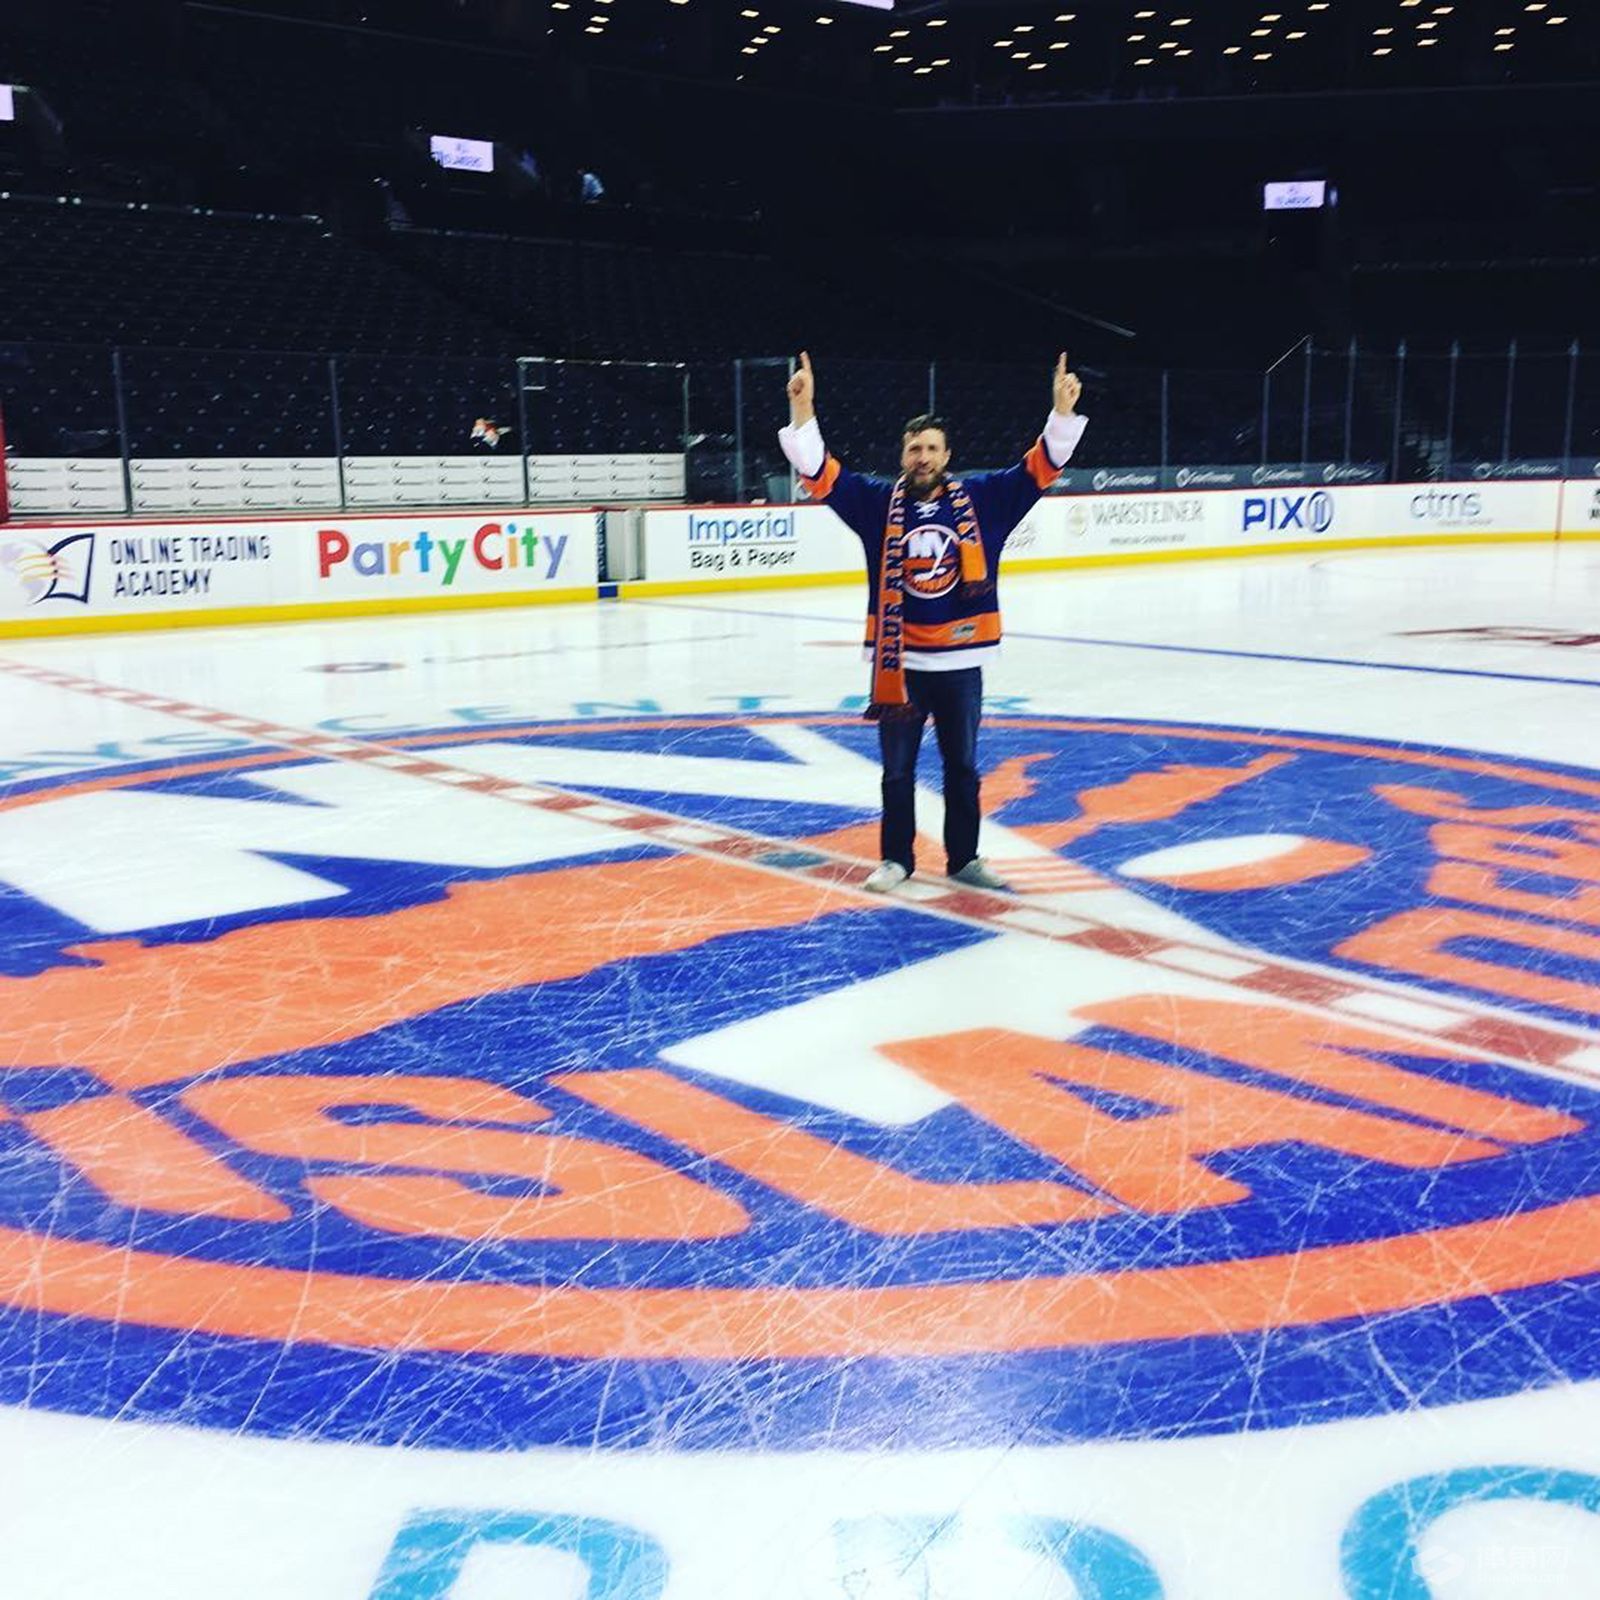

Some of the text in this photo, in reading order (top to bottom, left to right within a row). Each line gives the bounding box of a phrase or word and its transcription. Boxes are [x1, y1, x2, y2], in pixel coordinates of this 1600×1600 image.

[1091, 498, 1206, 526] WARSTEINER
[688, 511, 795, 545] Imperial
[110, 535, 271, 565] ONLINE TRADING
[691, 549, 796, 571] Bag & Paper
[114, 569, 211, 598] ACADEMY
